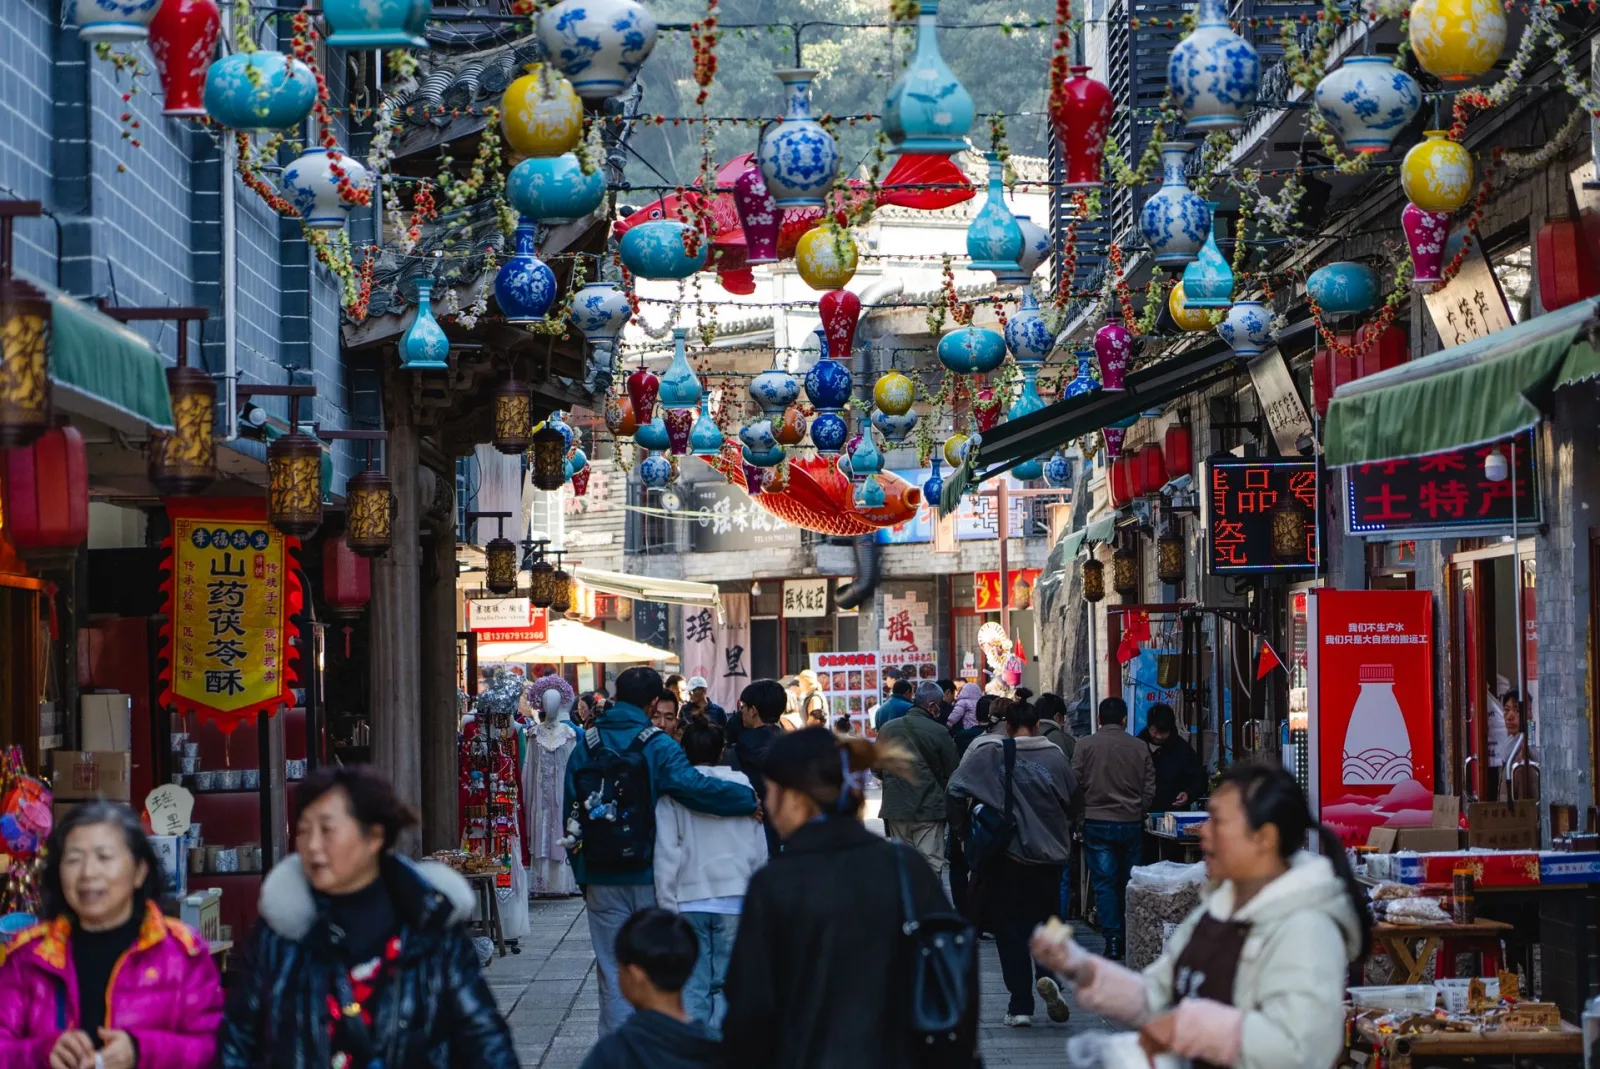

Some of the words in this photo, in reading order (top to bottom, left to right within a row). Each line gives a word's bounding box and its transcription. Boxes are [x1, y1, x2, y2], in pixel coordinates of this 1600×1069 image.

[1363, 479, 1525, 520] 土特产
[192, 528, 269, 550] 幸福瑶里
[182, 560, 195, 613] 传承经典
[204, 552, 248, 696] 山药茯苓酥
[886, 609, 919, 653] 瑶
[1325, 634, 1428, 645] 我们只是大自然的搬运工
[1348, 622, 1405, 632] 我们不生产水
[181, 625, 194, 682] 匠心制作
